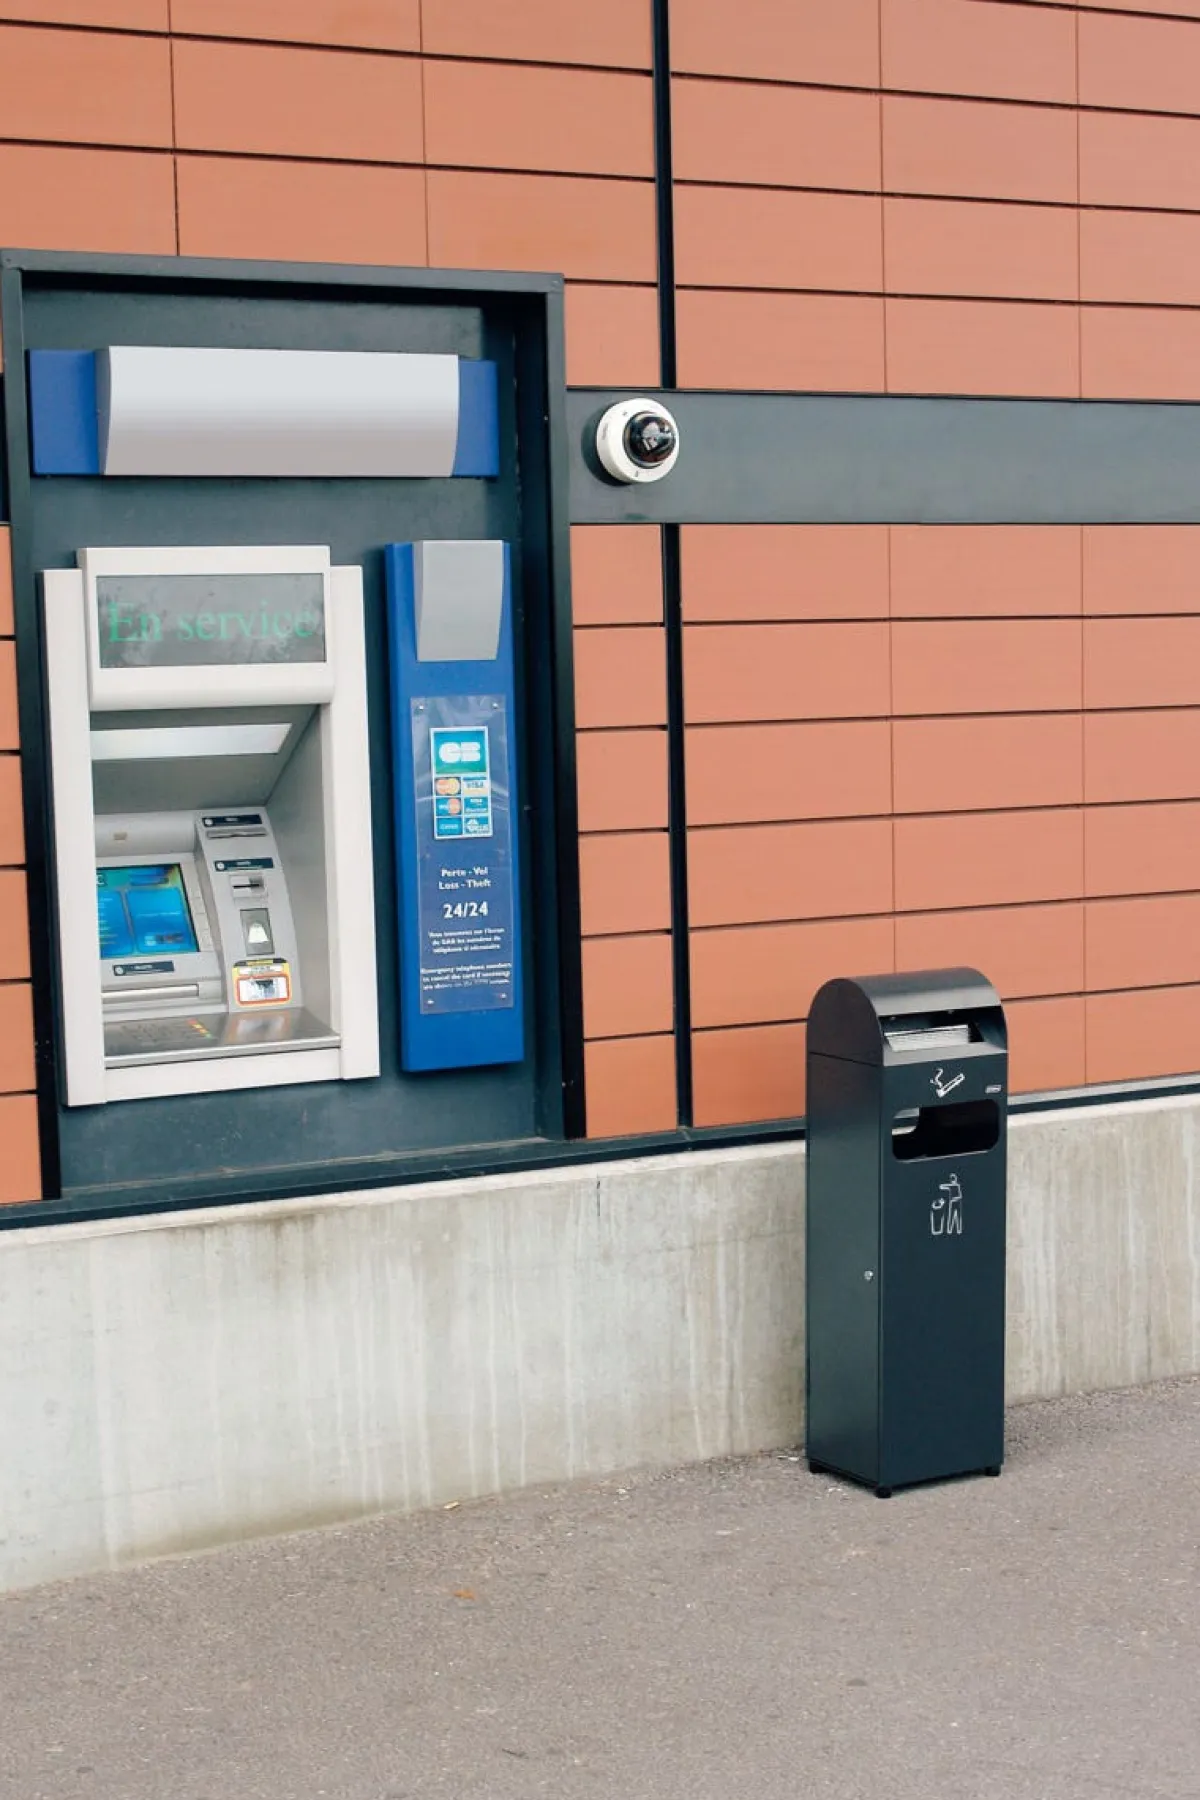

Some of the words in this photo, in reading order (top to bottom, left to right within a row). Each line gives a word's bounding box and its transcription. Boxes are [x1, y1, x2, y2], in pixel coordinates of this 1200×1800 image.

[107, 601, 163, 642] En
[176, 600, 315, 640] service
[441, 868, 466, 877] Perte
[473, 866, 488, 876] Vol
[438, 881, 460, 890] Loss
[466, 879, 491, 888] Theft
[443, 900, 489, 919] 24/24
